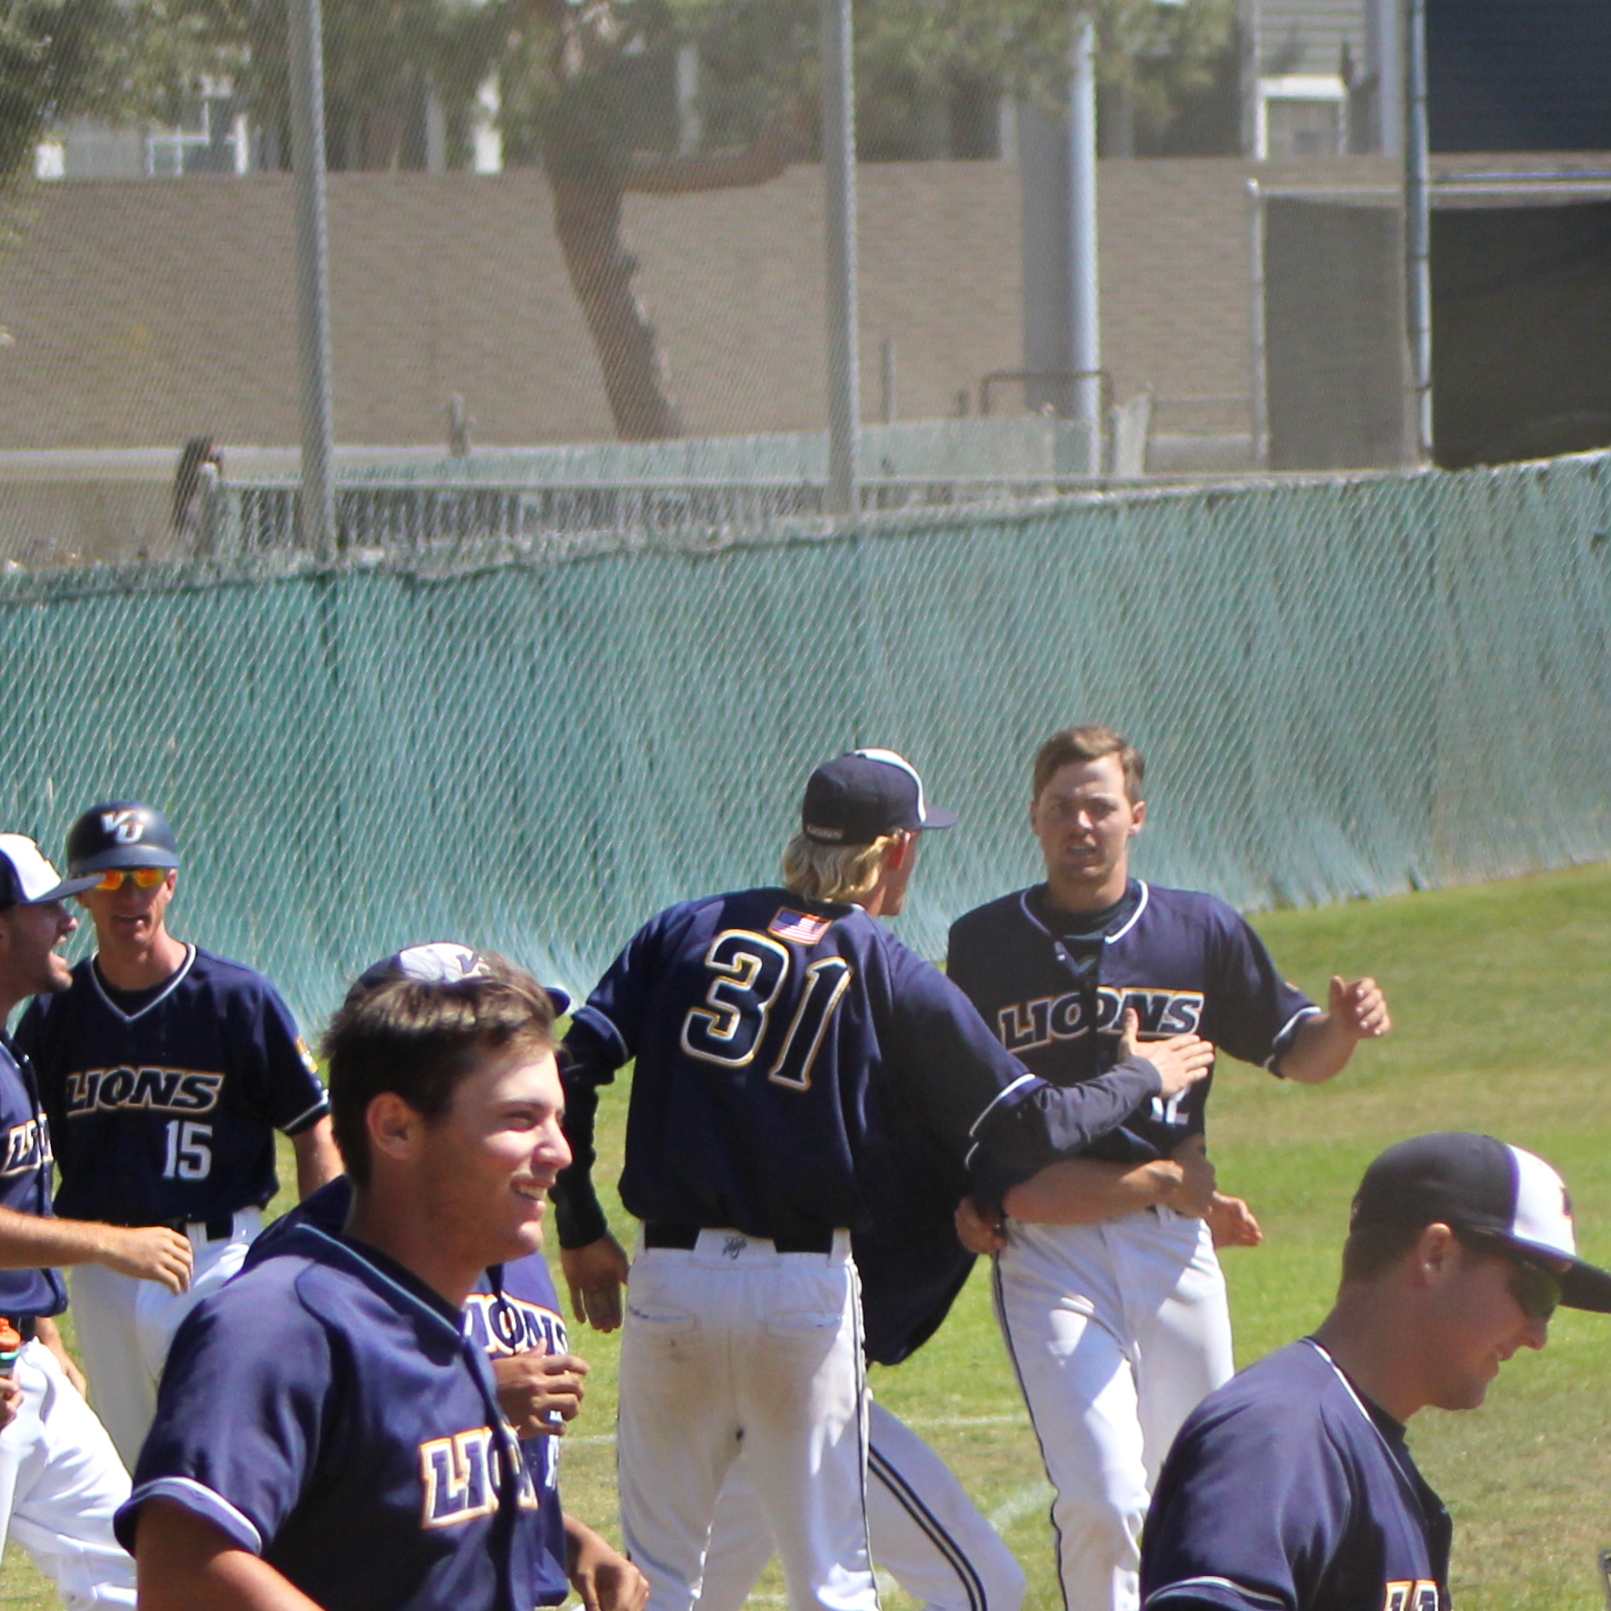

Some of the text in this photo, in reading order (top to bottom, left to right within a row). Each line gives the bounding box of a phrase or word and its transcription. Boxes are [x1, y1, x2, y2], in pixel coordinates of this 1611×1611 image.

[101, 810, 144, 844] VU
[680, 928, 851, 1091] 31
[998, 985, 1206, 1054] LIONS
[66, 1065, 225, 1118] LIONS
[162, 1119, 213, 1180] 15
